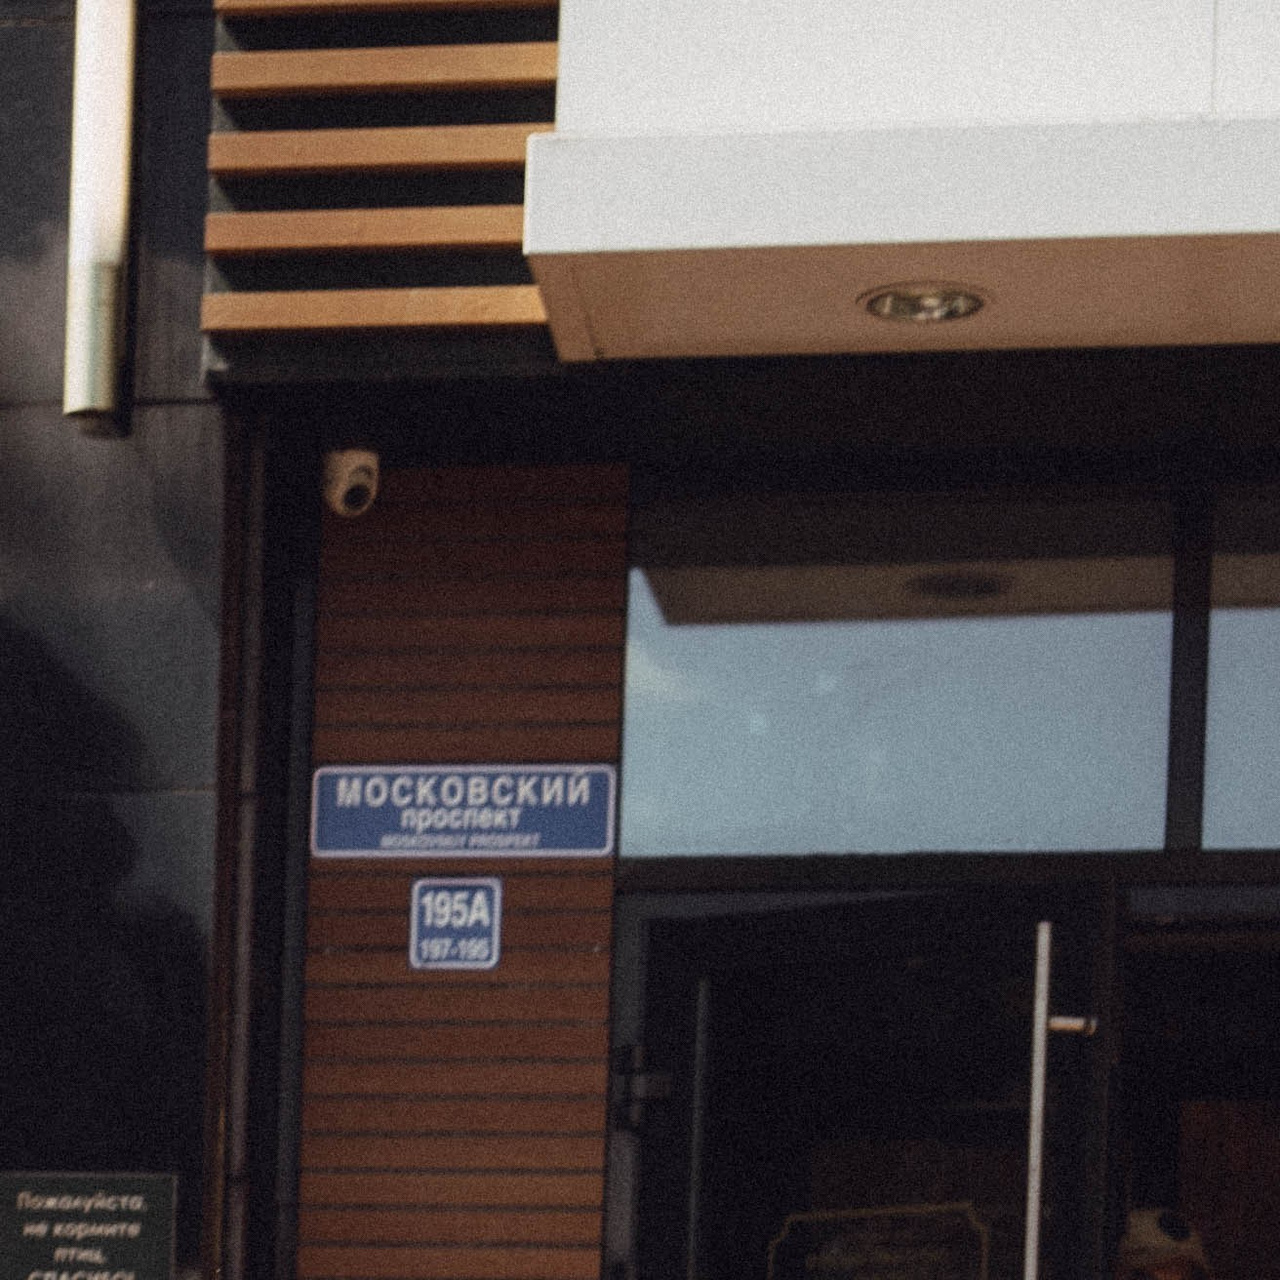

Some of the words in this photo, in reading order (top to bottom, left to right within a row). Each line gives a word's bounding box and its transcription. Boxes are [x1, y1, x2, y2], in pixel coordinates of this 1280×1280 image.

[335, 768, 591, 808] МОСКОВСКИЙ
[400, 807, 521, 833] проспект
[23, 1221, 49, 1238] не
[53, 1222, 142, 1241] кормите
